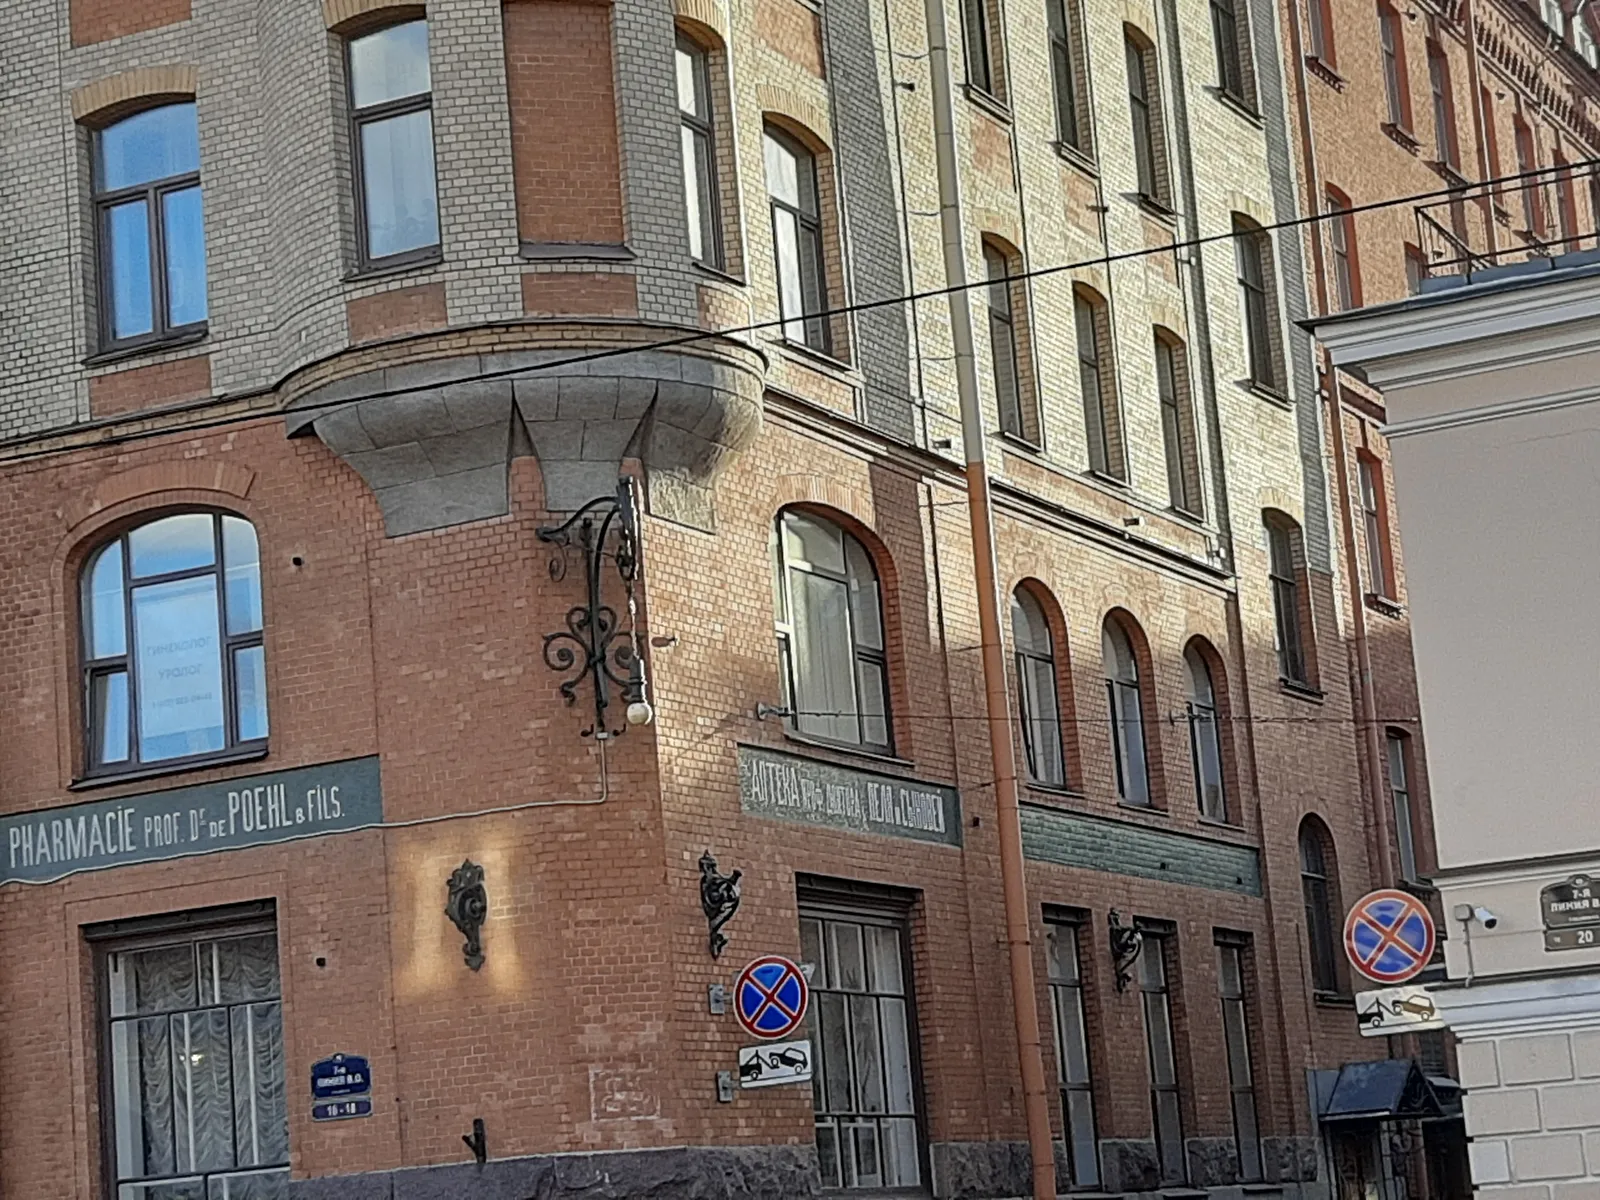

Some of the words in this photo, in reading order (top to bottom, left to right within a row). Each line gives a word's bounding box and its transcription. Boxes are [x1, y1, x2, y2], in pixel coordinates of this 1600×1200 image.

[751, 760, 800, 807] АПТЕКА
[144, 812, 186, 848] PROF.
[209, 819, 226, 838] DE
[228, 783, 293, 835] POEHL
[1577, 930, 1593, 944] 20
